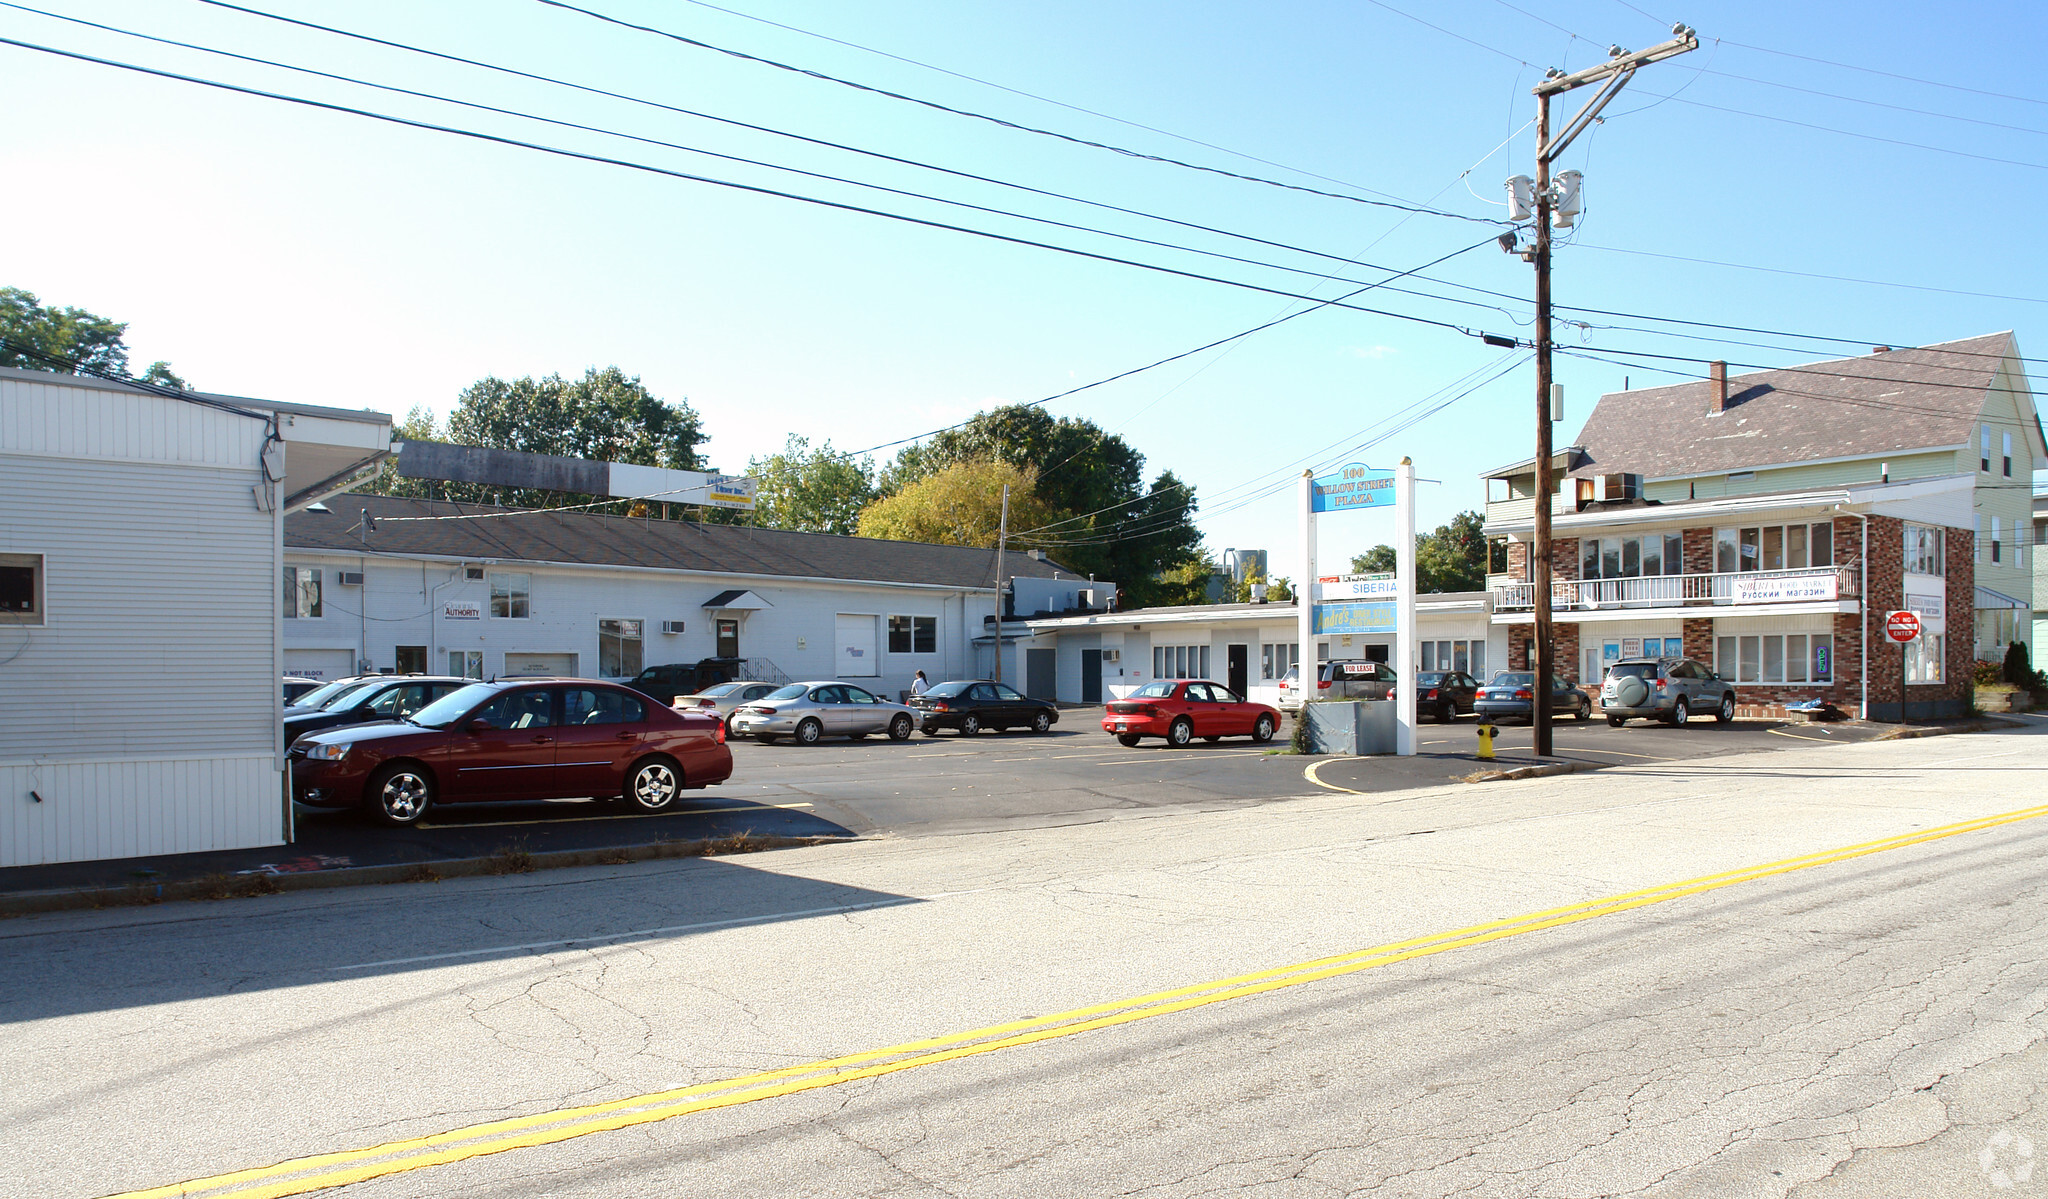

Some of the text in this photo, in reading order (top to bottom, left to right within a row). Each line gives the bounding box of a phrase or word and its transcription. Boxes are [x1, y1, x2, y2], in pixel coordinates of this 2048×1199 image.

[1343, 467, 1365, 480] 100
[1315, 477, 1395, 496] WILLOW STREET
[1335, 493, 1374, 507] PLAZA
[1353, 582, 1397, 593] SIBERIA
[1737, 579, 1832, 591] SIBERIA FOOD MARKET
[1353, 608, 1391, 618] DINER STYLE
[1350, 617, 1395, 626] RESTAURANT
